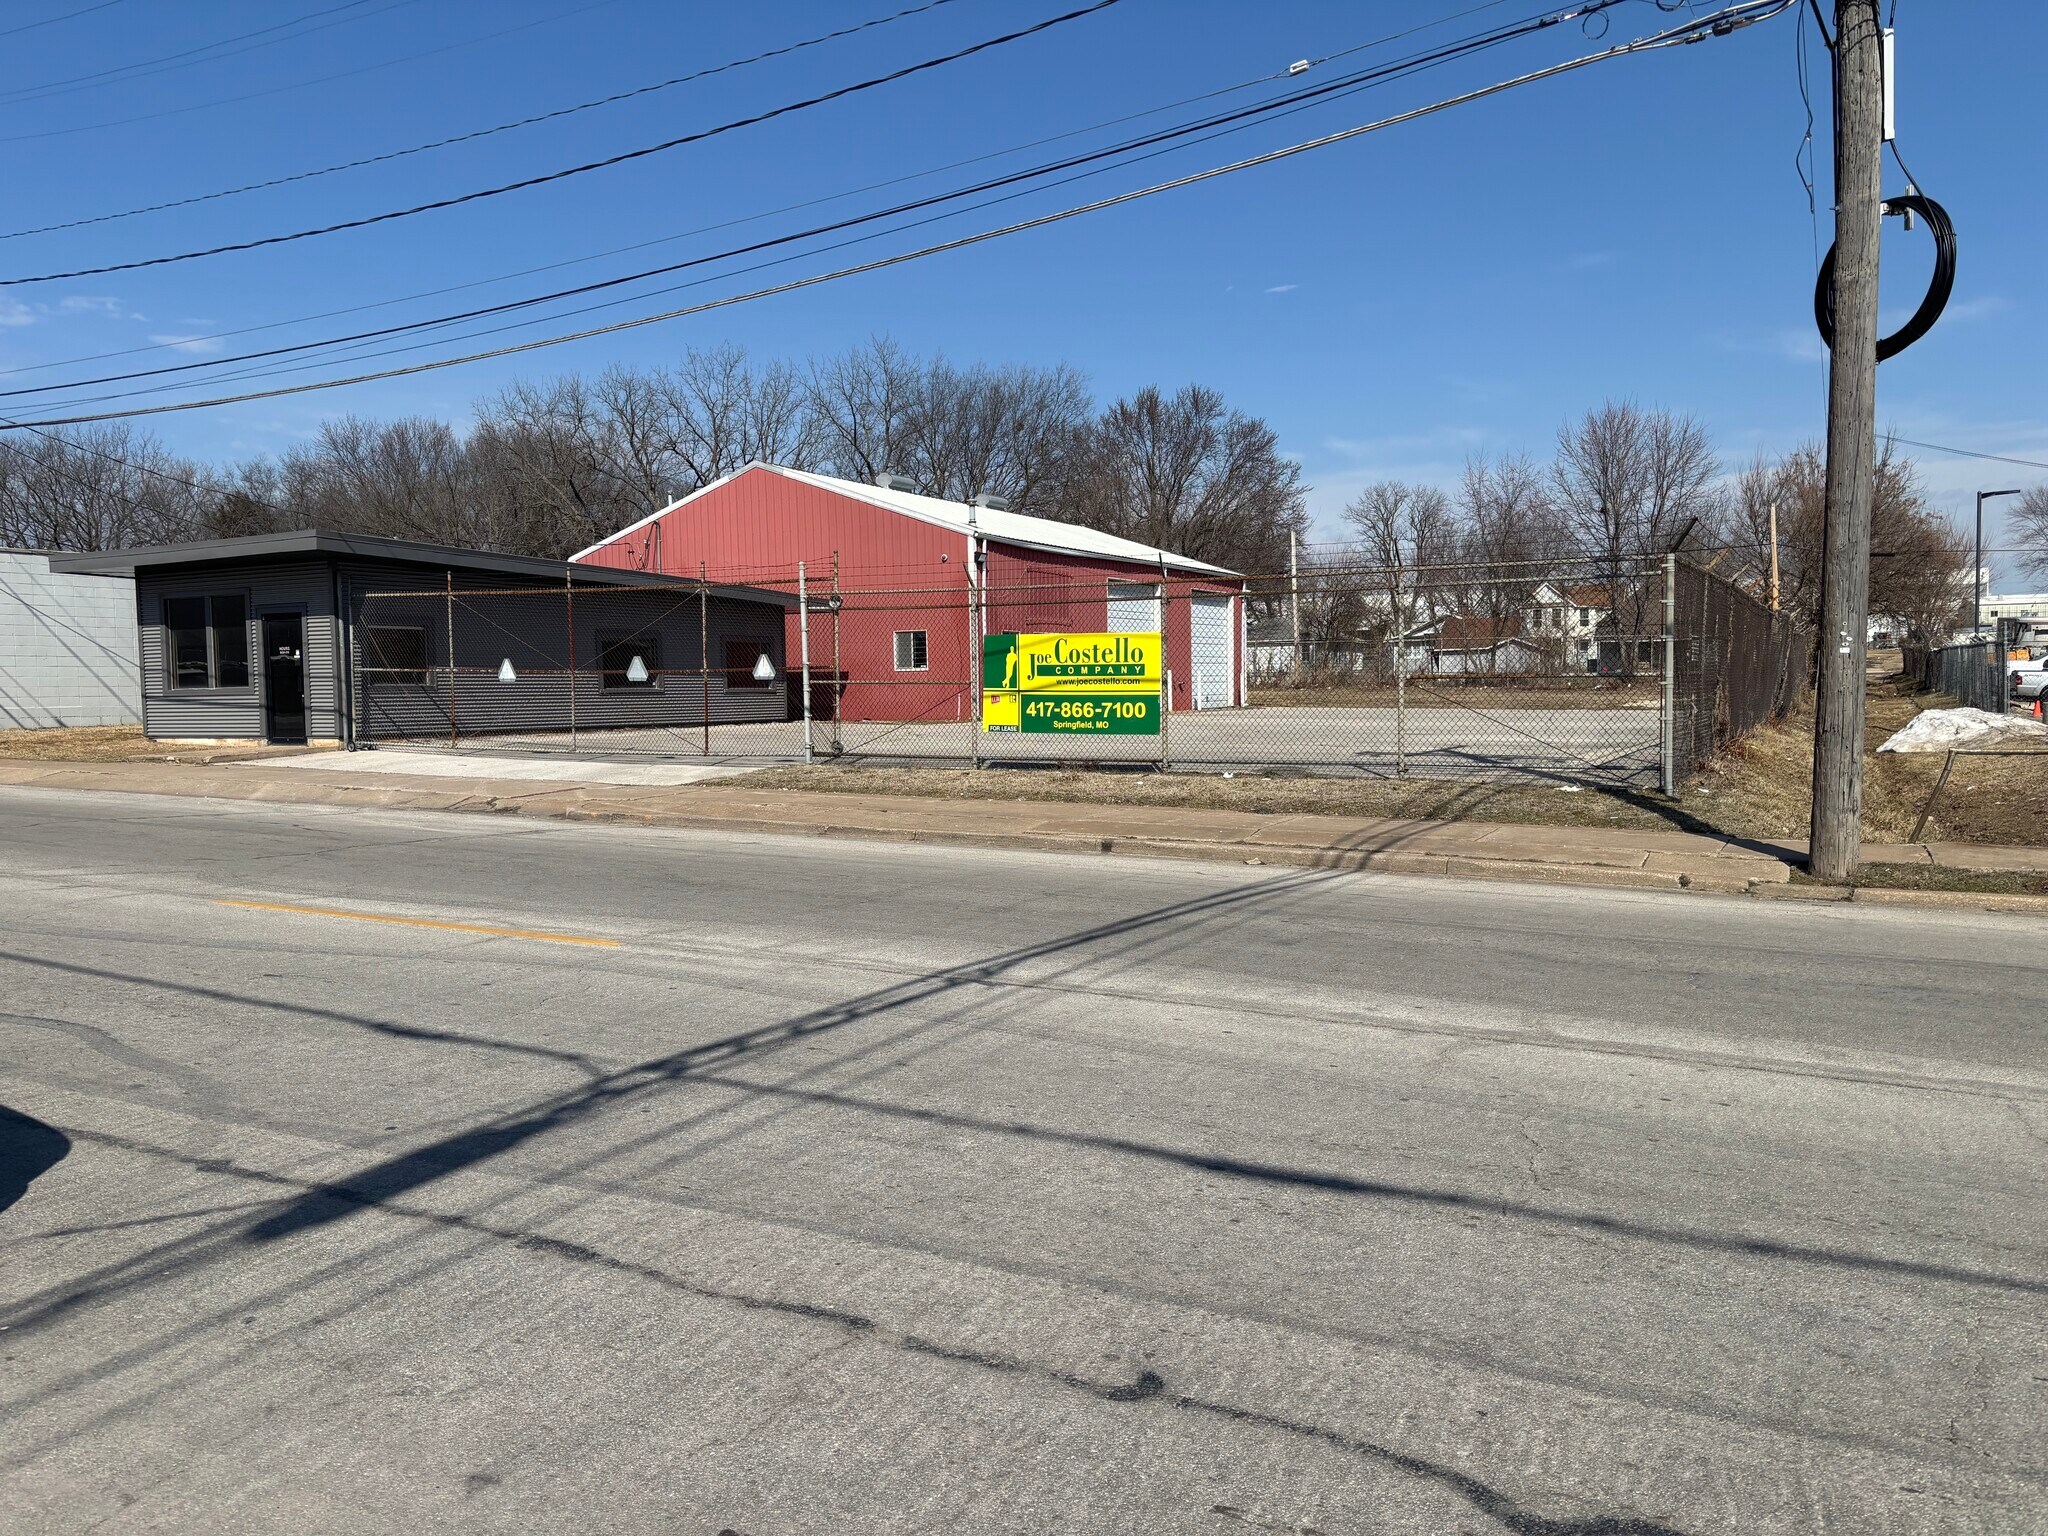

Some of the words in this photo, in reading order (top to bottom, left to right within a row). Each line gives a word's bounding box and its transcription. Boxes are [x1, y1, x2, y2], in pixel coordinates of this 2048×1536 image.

[1027, 653, 1052, 681] Joe
[1054, 637, 1144, 664] Costello
[1055, 666, 1141, 675] COMPANY
[1055, 678, 1141, 686] www.joecostello.com
[1026, 702, 1147, 718] 417-866-7100
[1053, 720, 1094, 730] Springfield,
[1096, 721, 1109, 729] MO
